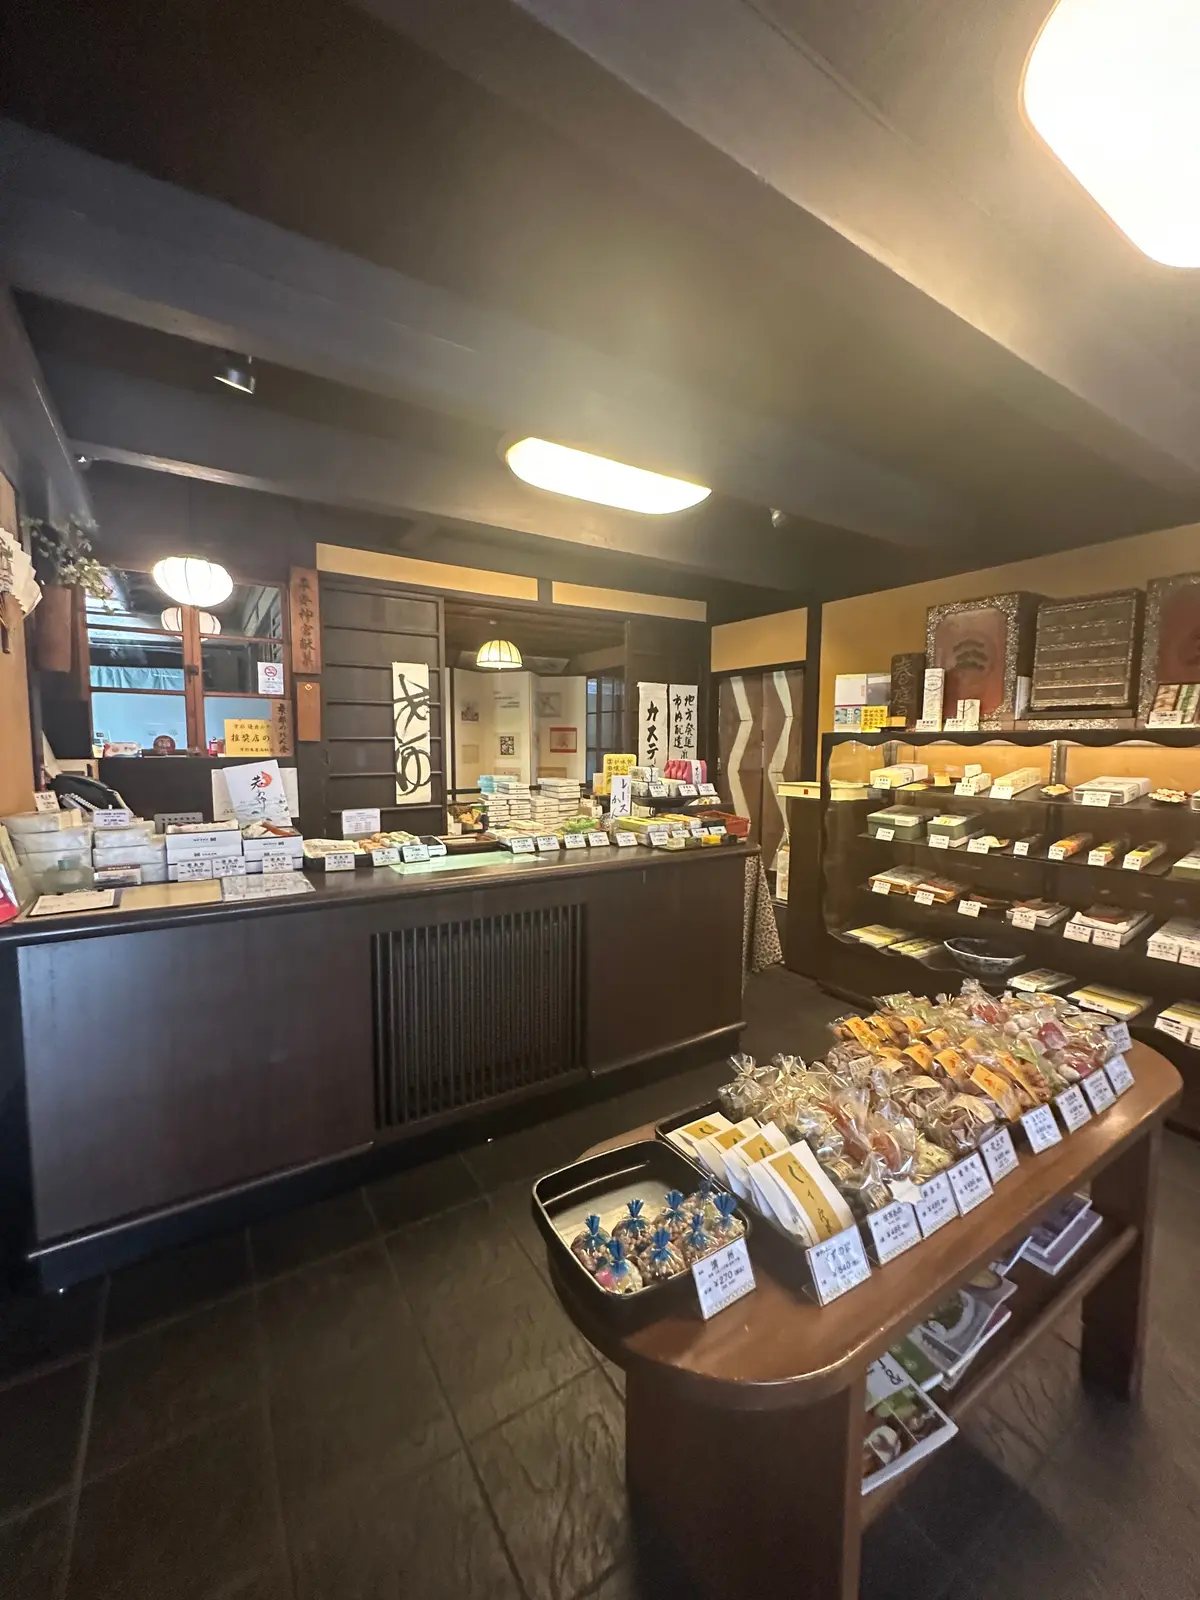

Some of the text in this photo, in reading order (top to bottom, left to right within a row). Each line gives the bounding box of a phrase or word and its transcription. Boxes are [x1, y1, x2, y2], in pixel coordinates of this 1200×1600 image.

[619, 778, 628, 812] レース
[713, 1270, 733, 1288] ¥270
